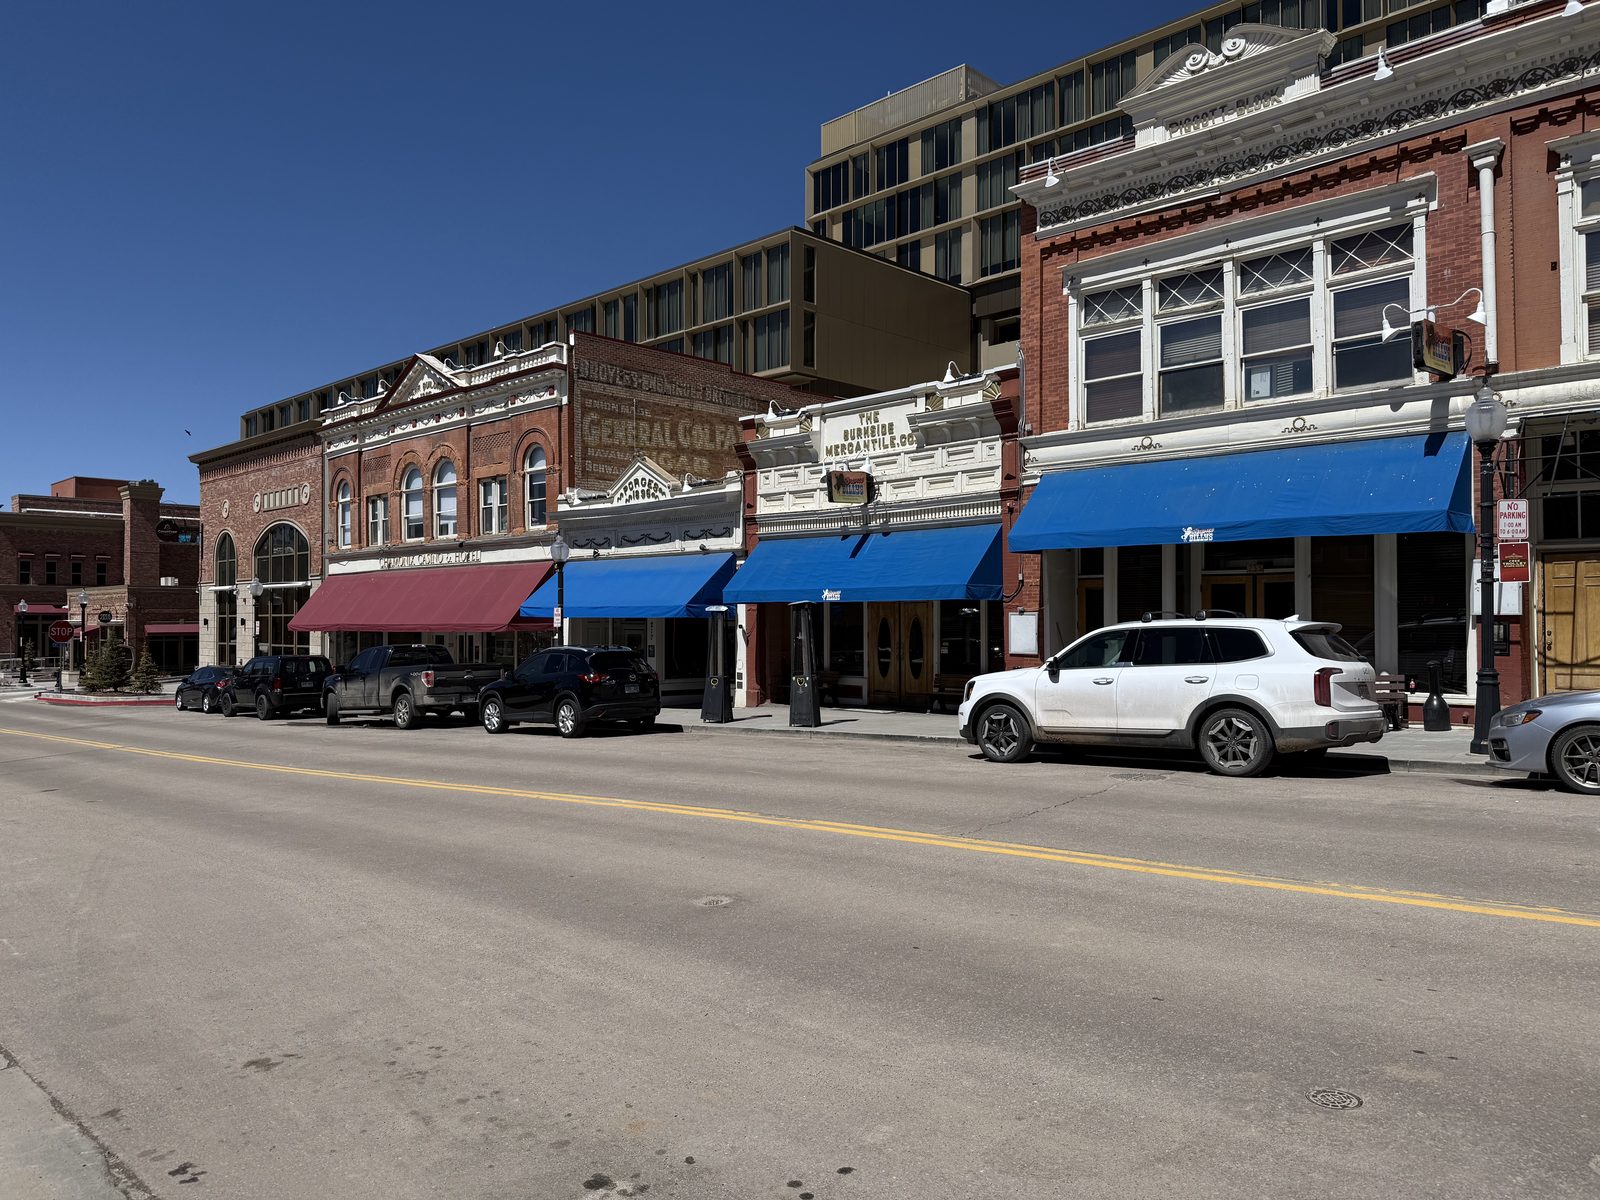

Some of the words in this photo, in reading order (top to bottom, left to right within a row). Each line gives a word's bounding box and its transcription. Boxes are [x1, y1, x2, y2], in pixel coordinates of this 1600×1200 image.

[859, 410, 880, 425] THE
[843, 422, 894, 442] BURNSIDE
[51, 628, 72, 636] STOP
